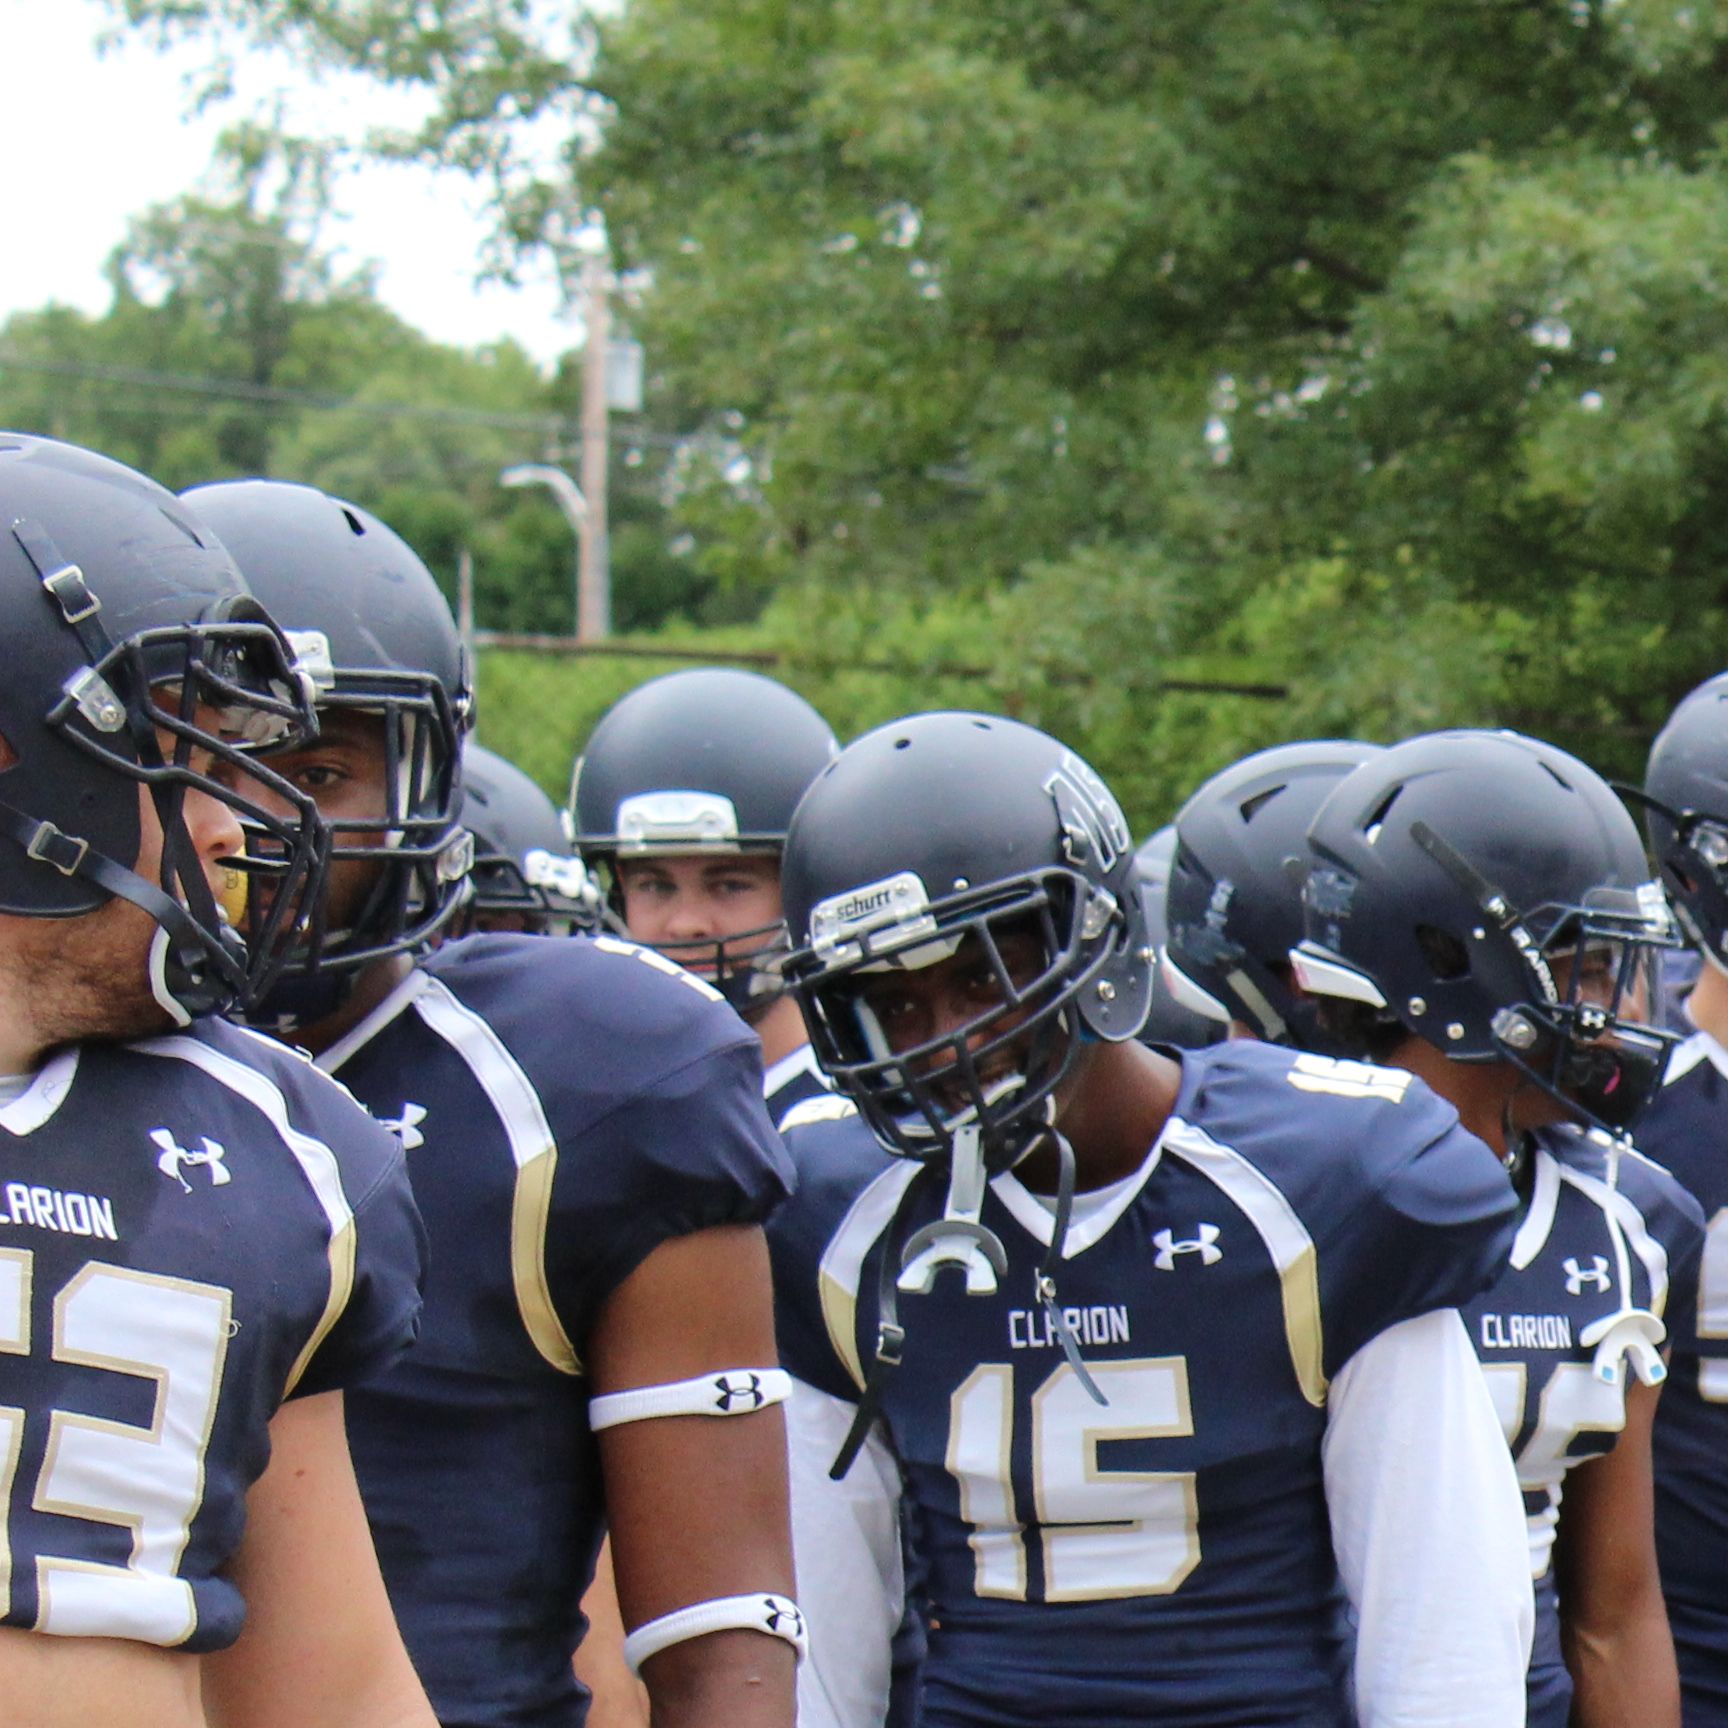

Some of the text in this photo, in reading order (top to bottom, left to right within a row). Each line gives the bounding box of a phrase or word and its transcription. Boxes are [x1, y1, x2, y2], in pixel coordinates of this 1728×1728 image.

[836, 888, 892, 921] schutt
[1008, 1305, 1130, 1349] CLARION
[1481, 1313, 1572, 1350] CLARION
[0, 1247, 234, 1647] 3
[944, 1354, 1202, 1603] 15
